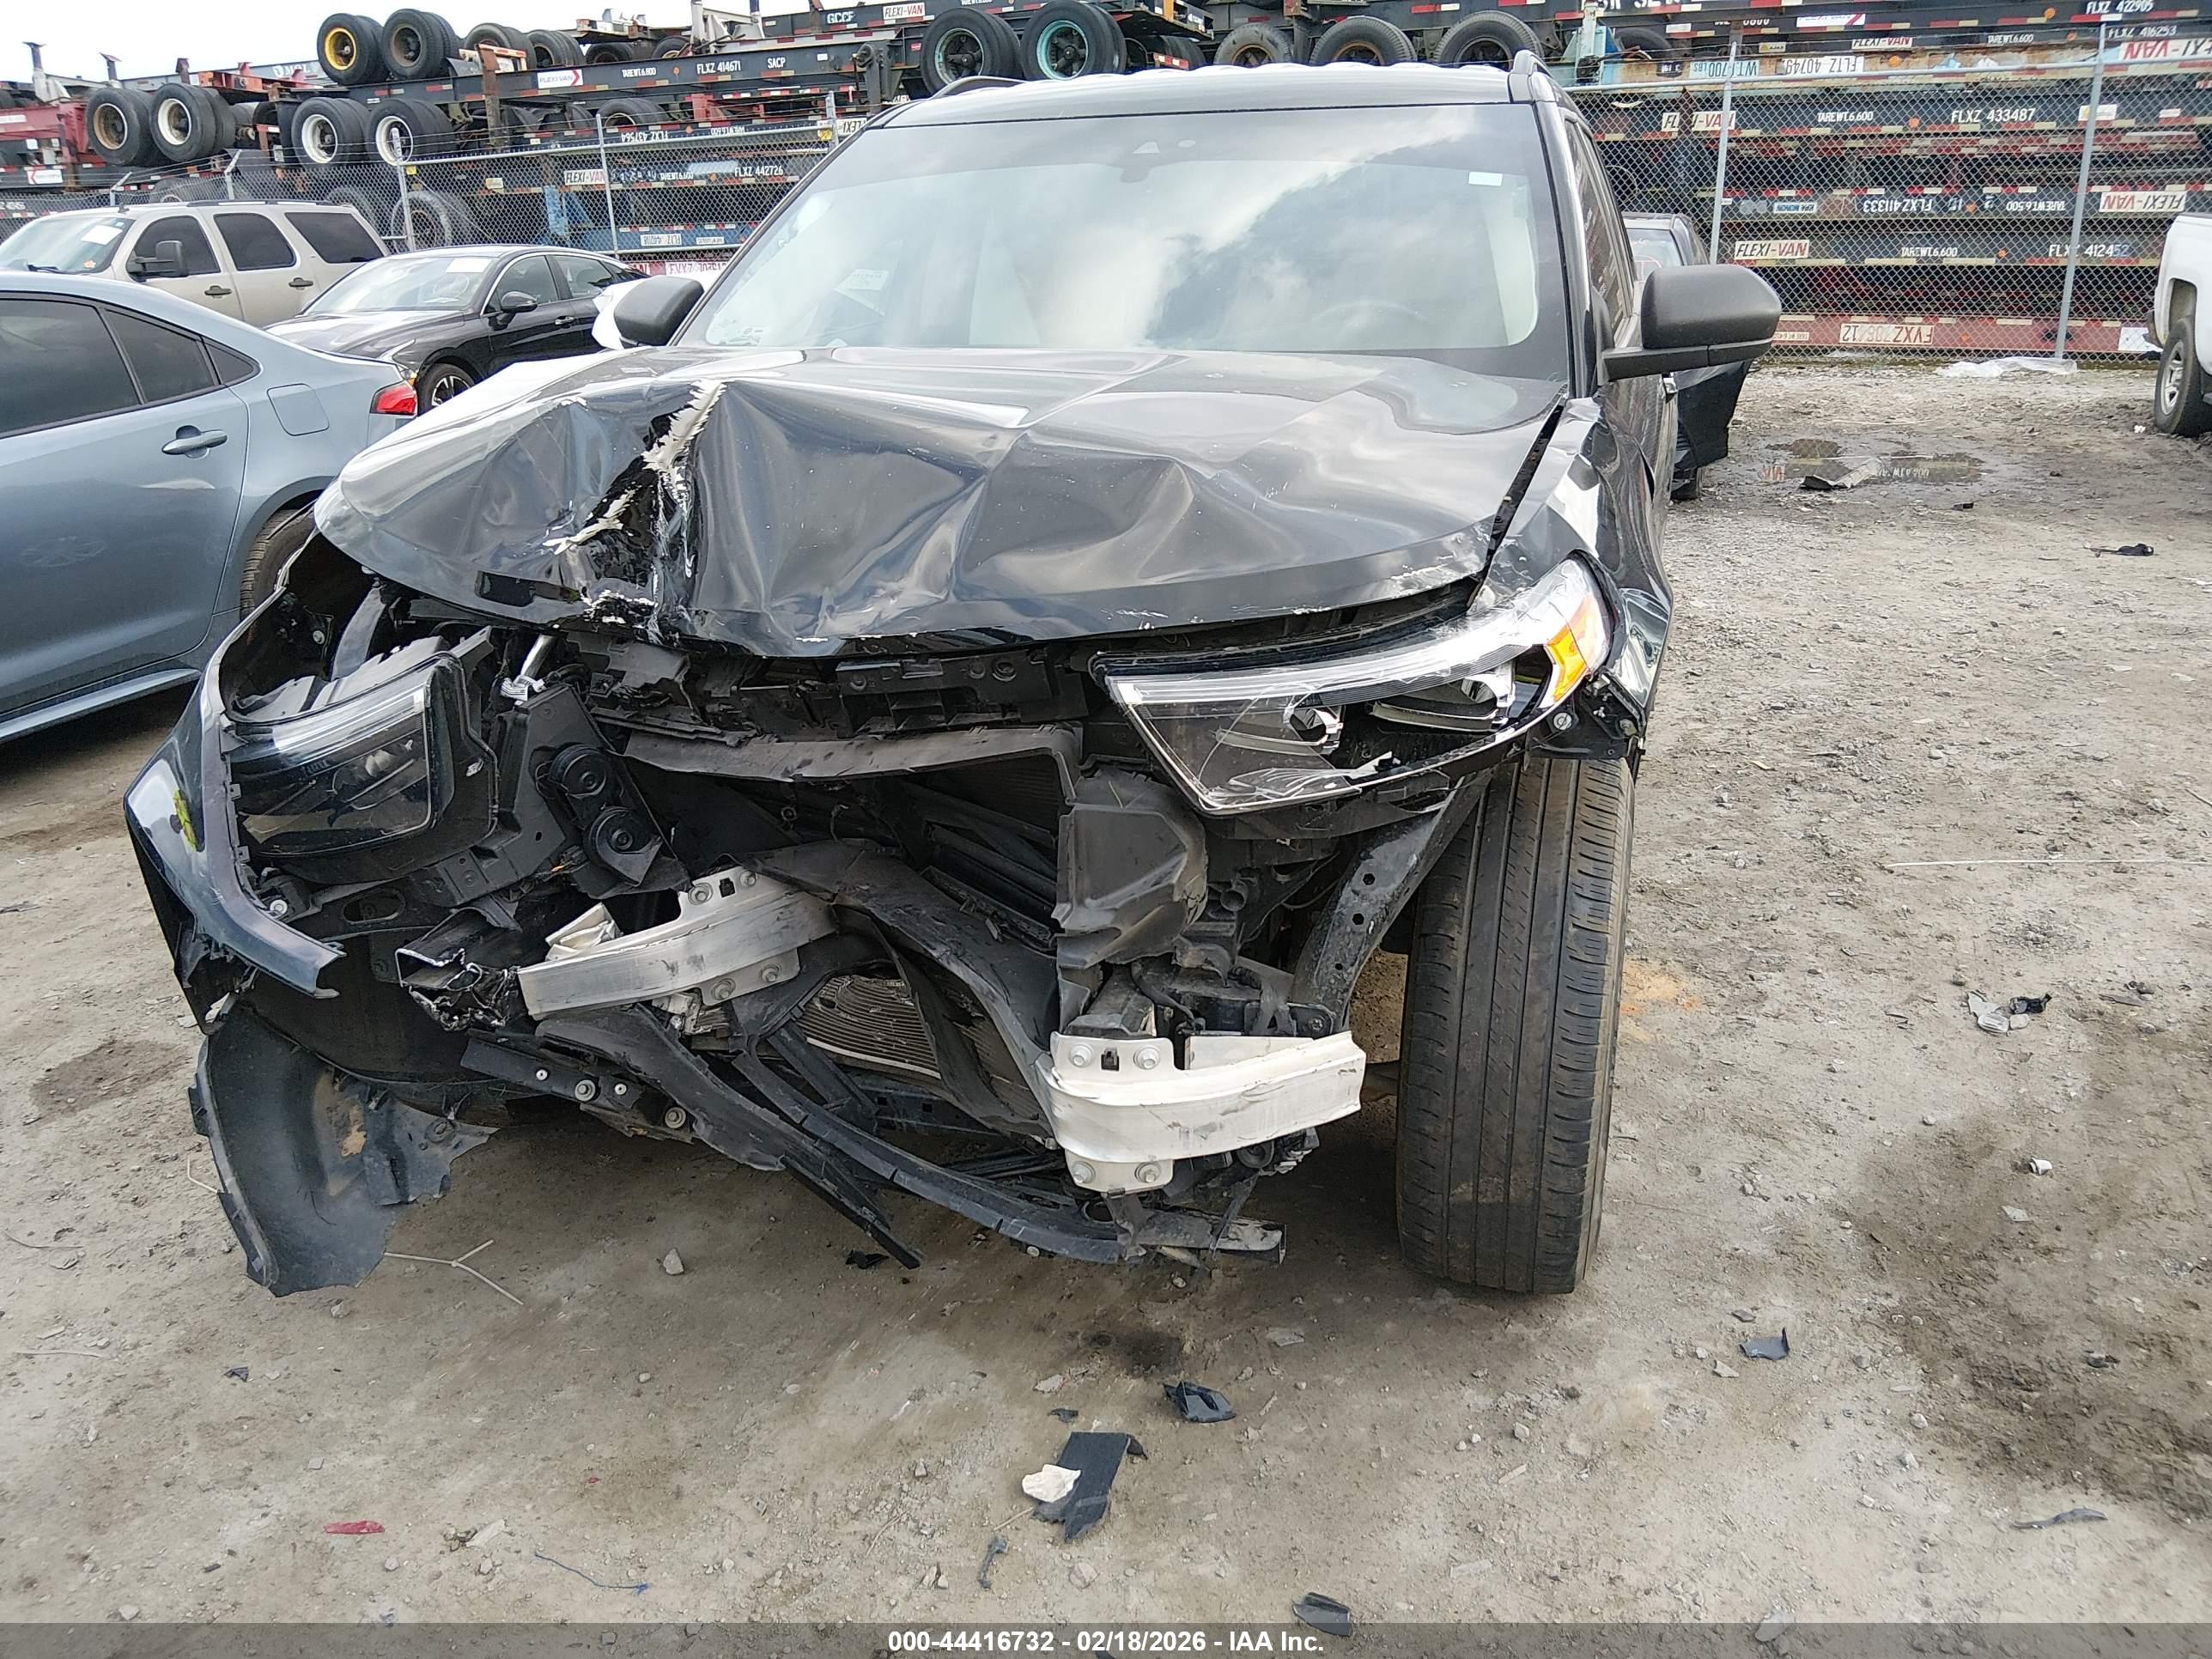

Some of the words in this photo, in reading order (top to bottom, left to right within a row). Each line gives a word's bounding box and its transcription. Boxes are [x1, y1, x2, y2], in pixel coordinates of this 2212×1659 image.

[884, 4, 923, 18] FLEXI-VAN
[2086, 1, 2110, 14] FLXZ
[696, 62, 716, 75] FLXZ
[718, 60, 741, 72] 414671
[768, 57, 787, 69] SACP
[1783, 59, 1821, 75] 40749
[1830, 58, 1856, 73] FLTZ
[1951, 110, 1982, 124] FLXZ
[1986, 107, 2036, 122] 433487
[734, 167, 753, 178] FLXZ
[755, 165, 784, 177] 442726
[2104, 194, 2185, 211] FLEXI-VAN
[1736, 243, 1808, 258] FLEXI-VAN
[2084, 244, 2130, 257] 412452
[1893, 325, 1933, 343] FVXZ
